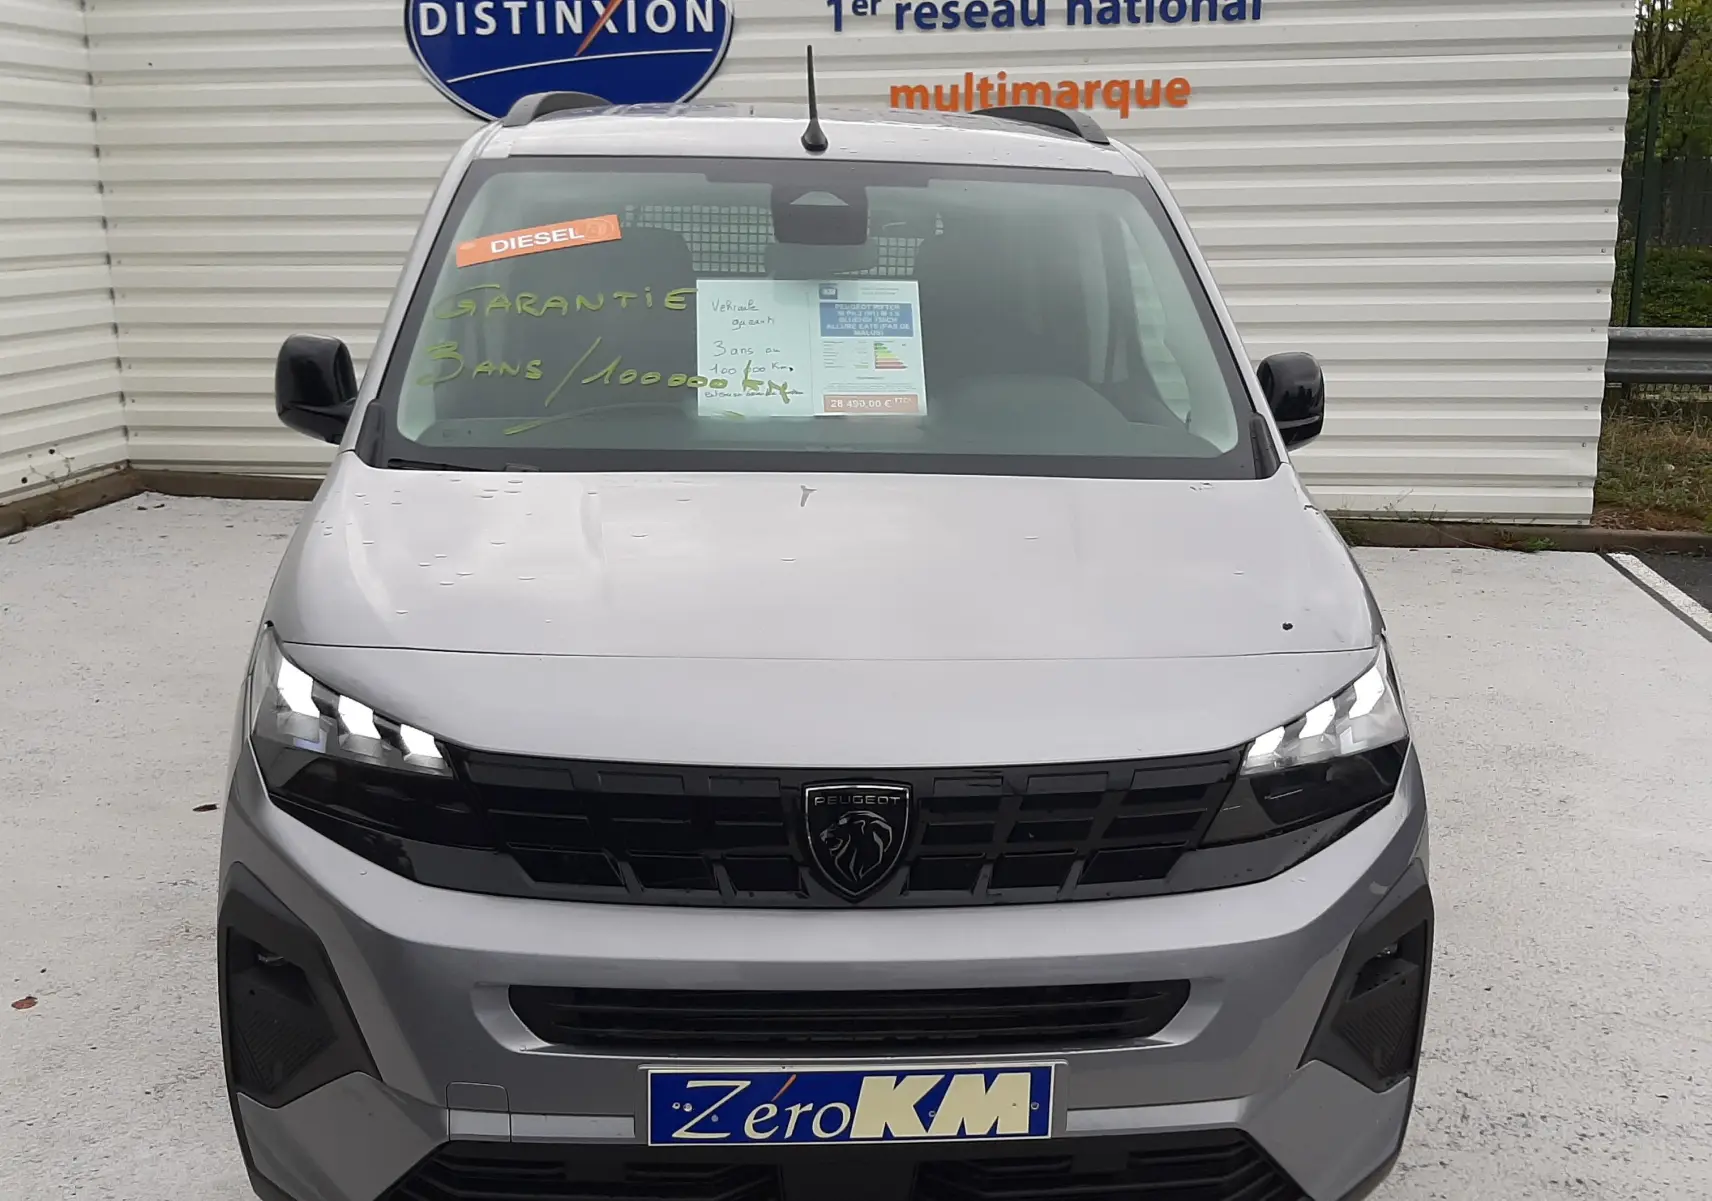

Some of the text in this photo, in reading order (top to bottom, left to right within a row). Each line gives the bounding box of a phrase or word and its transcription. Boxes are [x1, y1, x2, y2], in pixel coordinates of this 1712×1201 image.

[418, 0, 715, 36] DISTINXION
[888, 70, 1192, 120] multimarque
[490, 227, 585, 254] DIESEL
[713, 340, 727, 357] 3
[730, 347, 754, 355] ans
[814, 795, 901, 806] PEUGEOT
